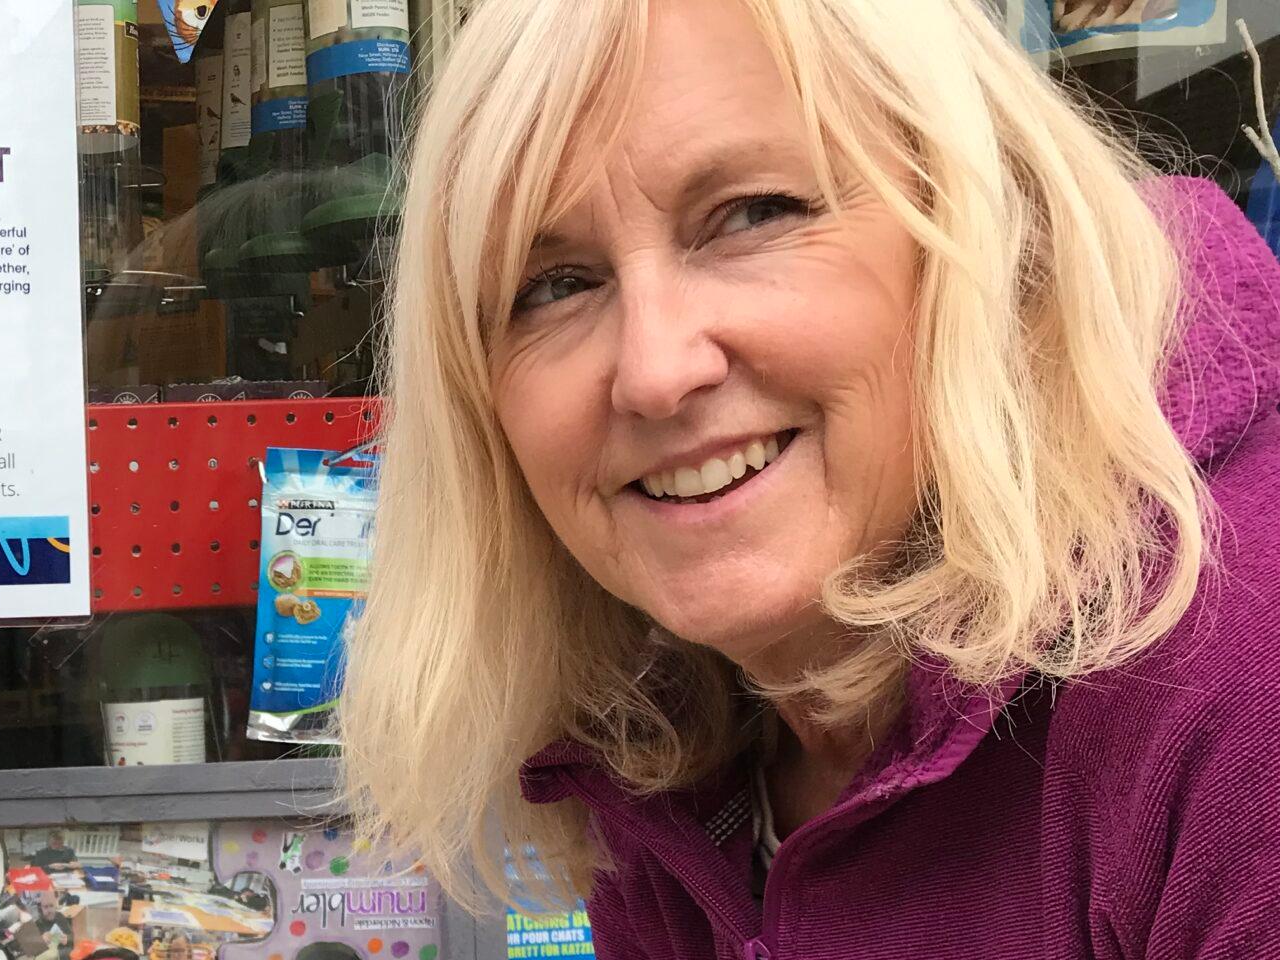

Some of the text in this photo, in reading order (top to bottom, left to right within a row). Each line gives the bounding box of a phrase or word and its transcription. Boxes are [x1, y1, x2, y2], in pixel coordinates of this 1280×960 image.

[18, 244, 30, 256] of
[291, 891, 427, 929] mumbler
[522, 928, 586, 945] POUR CHATS
